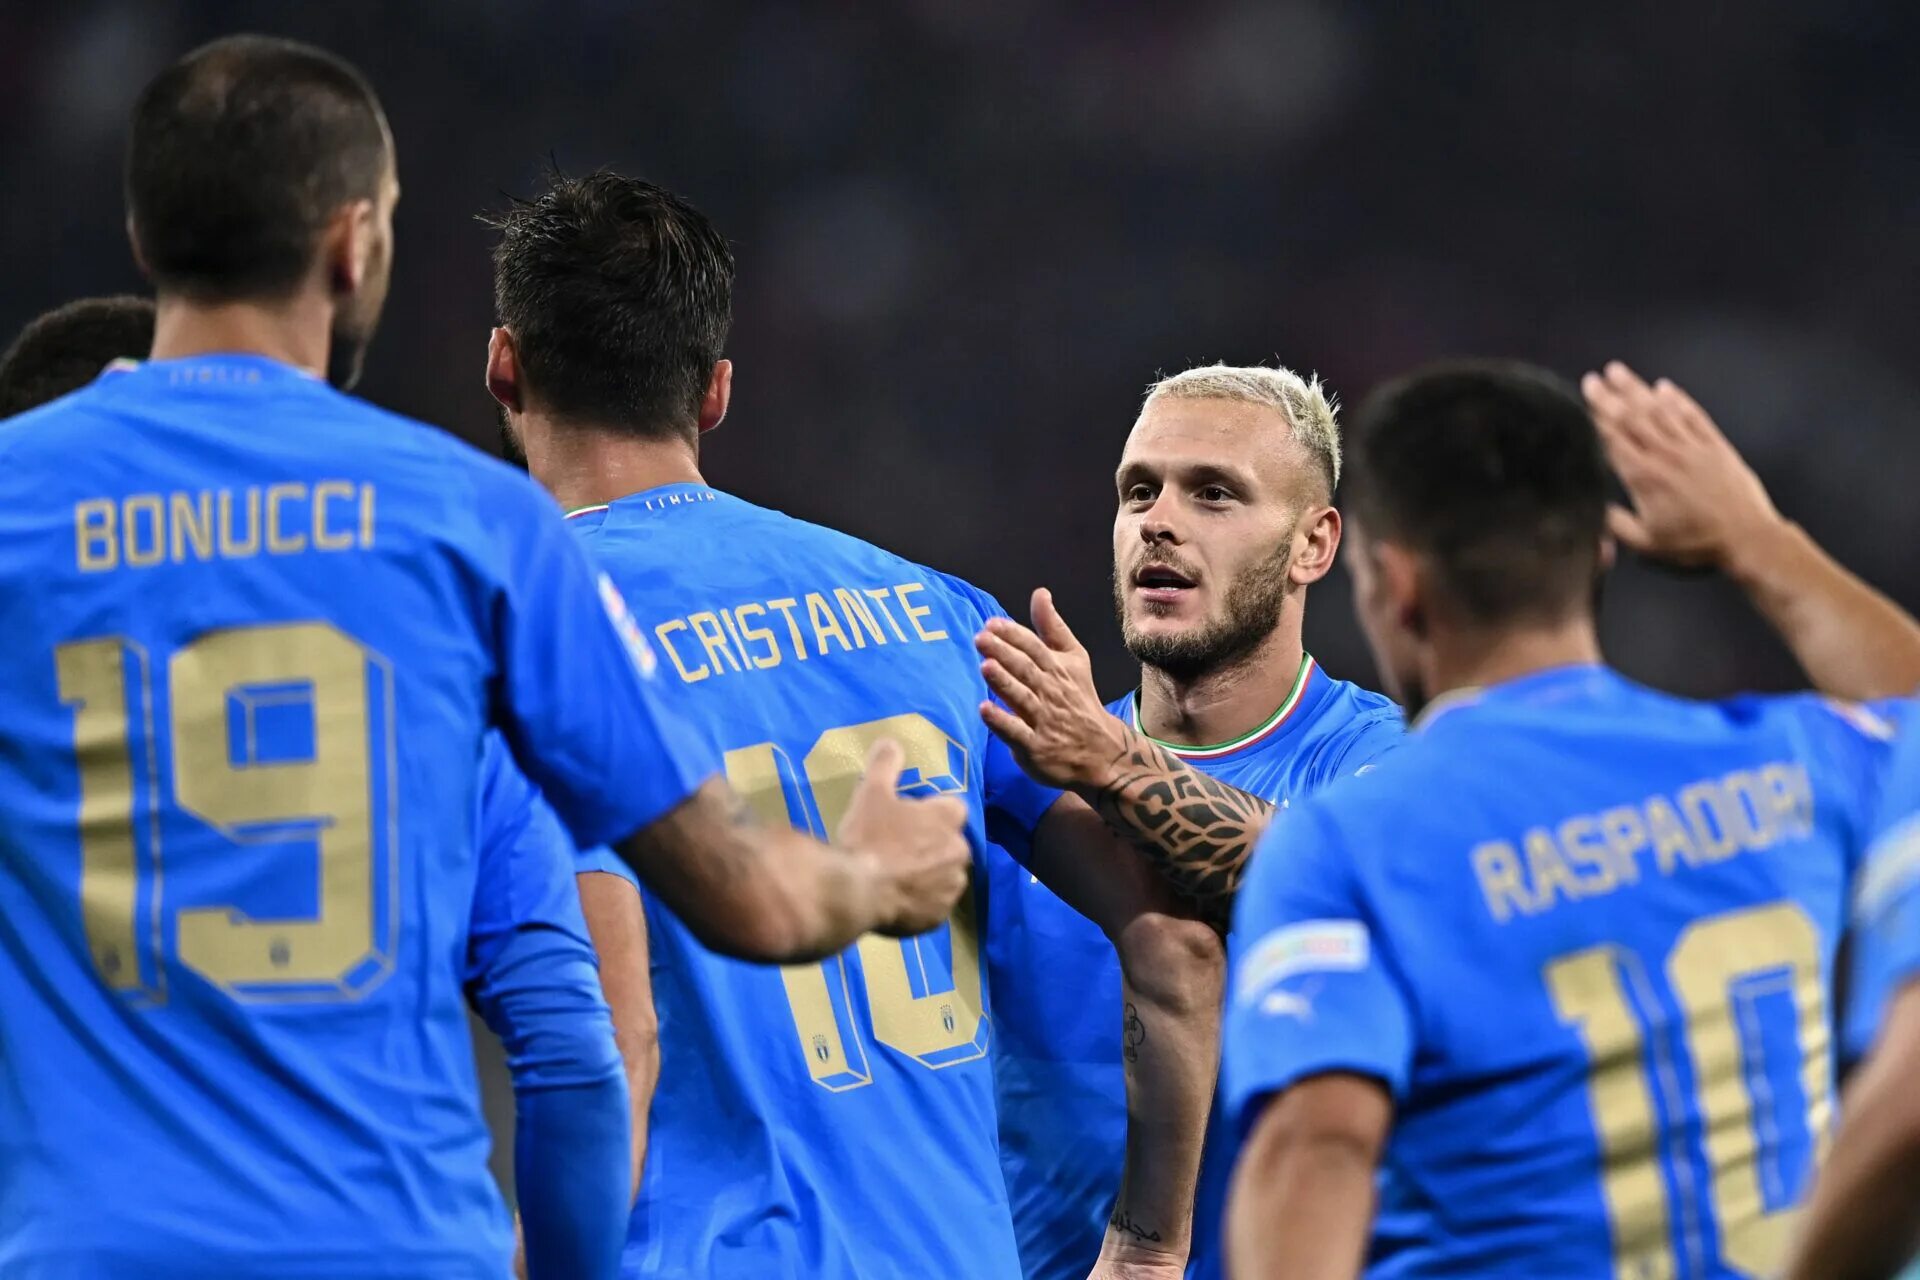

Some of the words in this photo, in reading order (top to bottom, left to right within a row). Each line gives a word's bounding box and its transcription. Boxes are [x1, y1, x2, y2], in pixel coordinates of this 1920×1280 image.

[75, 479, 376, 573] BONUCCI
[655, 582, 949, 684] CRISTANTE
[54, 619, 394, 1009] 19
[723, 712, 991, 1092] 16
[1543, 901, 1837, 1280] 10
